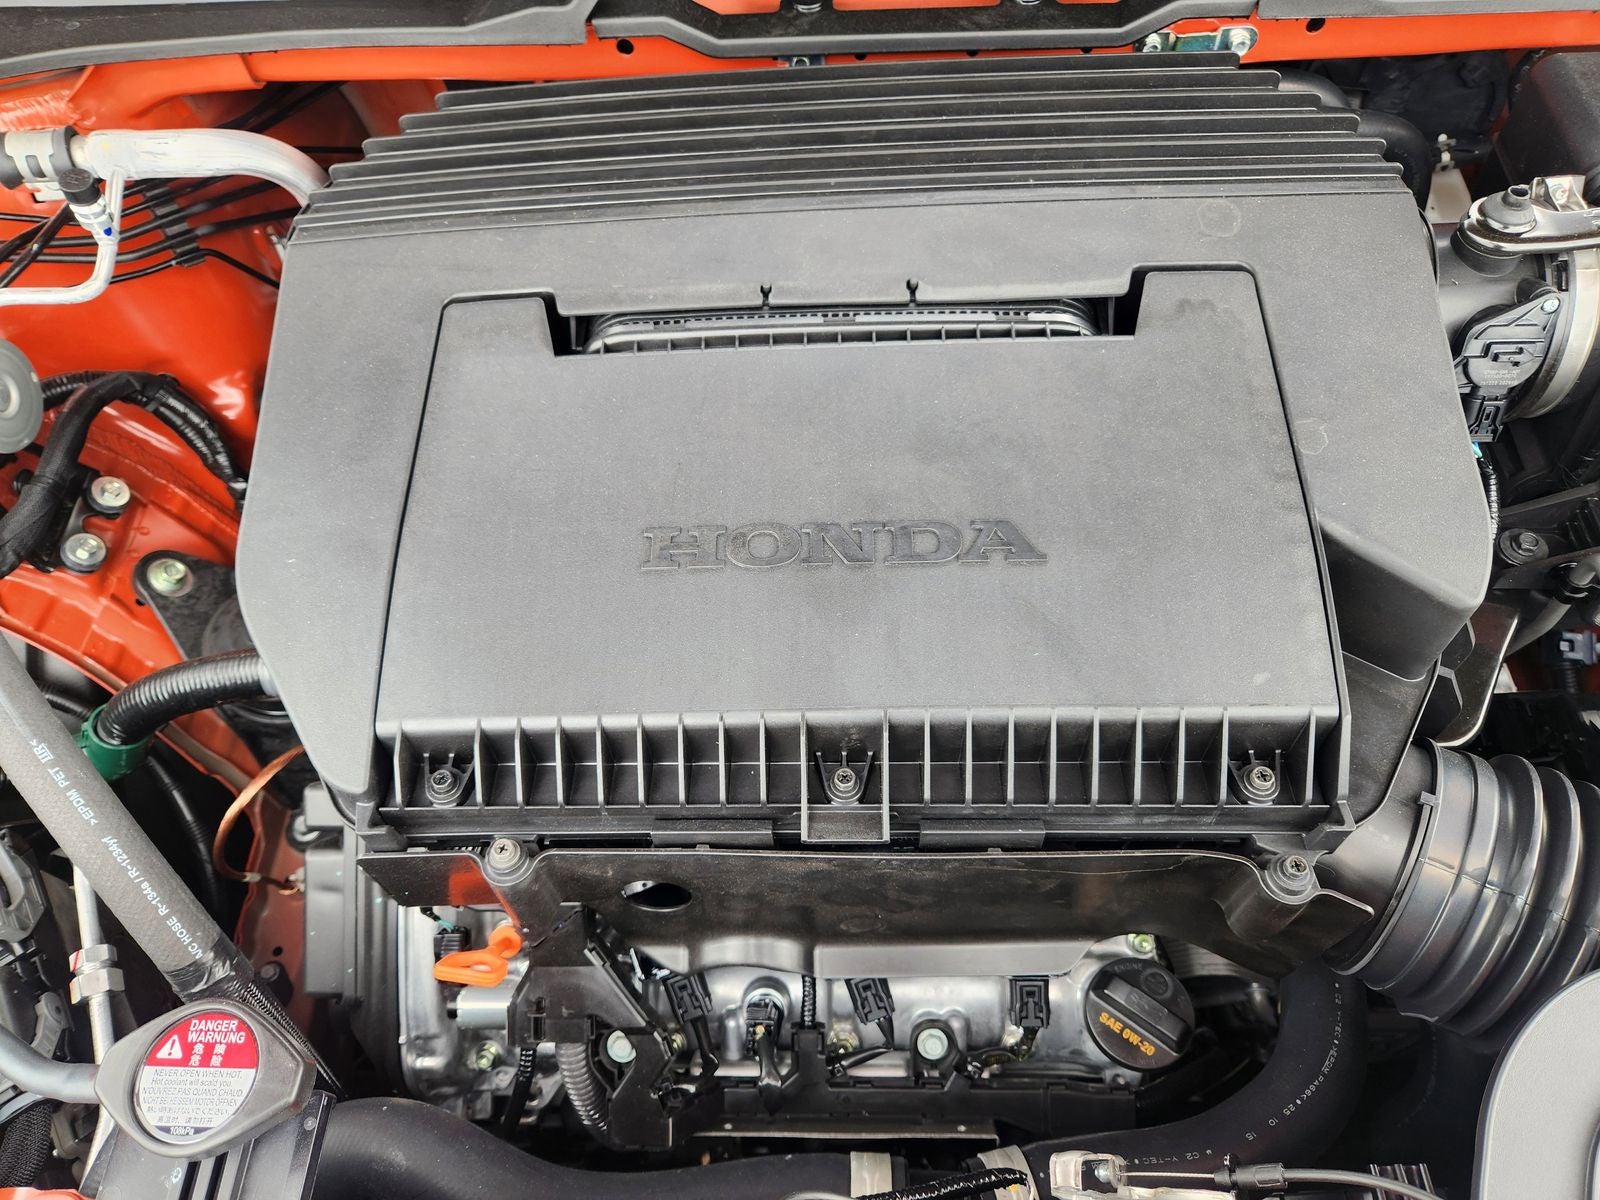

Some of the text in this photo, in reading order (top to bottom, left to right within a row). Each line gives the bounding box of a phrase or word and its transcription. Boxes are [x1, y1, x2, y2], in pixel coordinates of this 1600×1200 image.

[640, 518, 1049, 571] HONDA
[48, 767, 70, 788] PET
[101, 836, 140, 879] R-1234yf
[140, 881, 170, 916] R-134a
[166, 916, 192, 945] HOSE
[189, 1019, 238, 1031] DANGER
[187, 1031, 246, 1043] WARNUNG
[1099, 1011, 1156, 1056] SAE 0W-20
[154, 1069, 179, 1077] NEVER
[180, 1069, 200, 1078] OPEN
[201, 1070, 225, 1078] WHEN
[152, 1077, 164, 1085] Hot
[164, 1078, 187, 1086] coolant
[200, 1079, 218, 1087] scald
[178, 1088, 191, 1096] PAS
[192, 1088, 217, 1096] QUAND
[1283, 1104, 1296, 1116] 25
